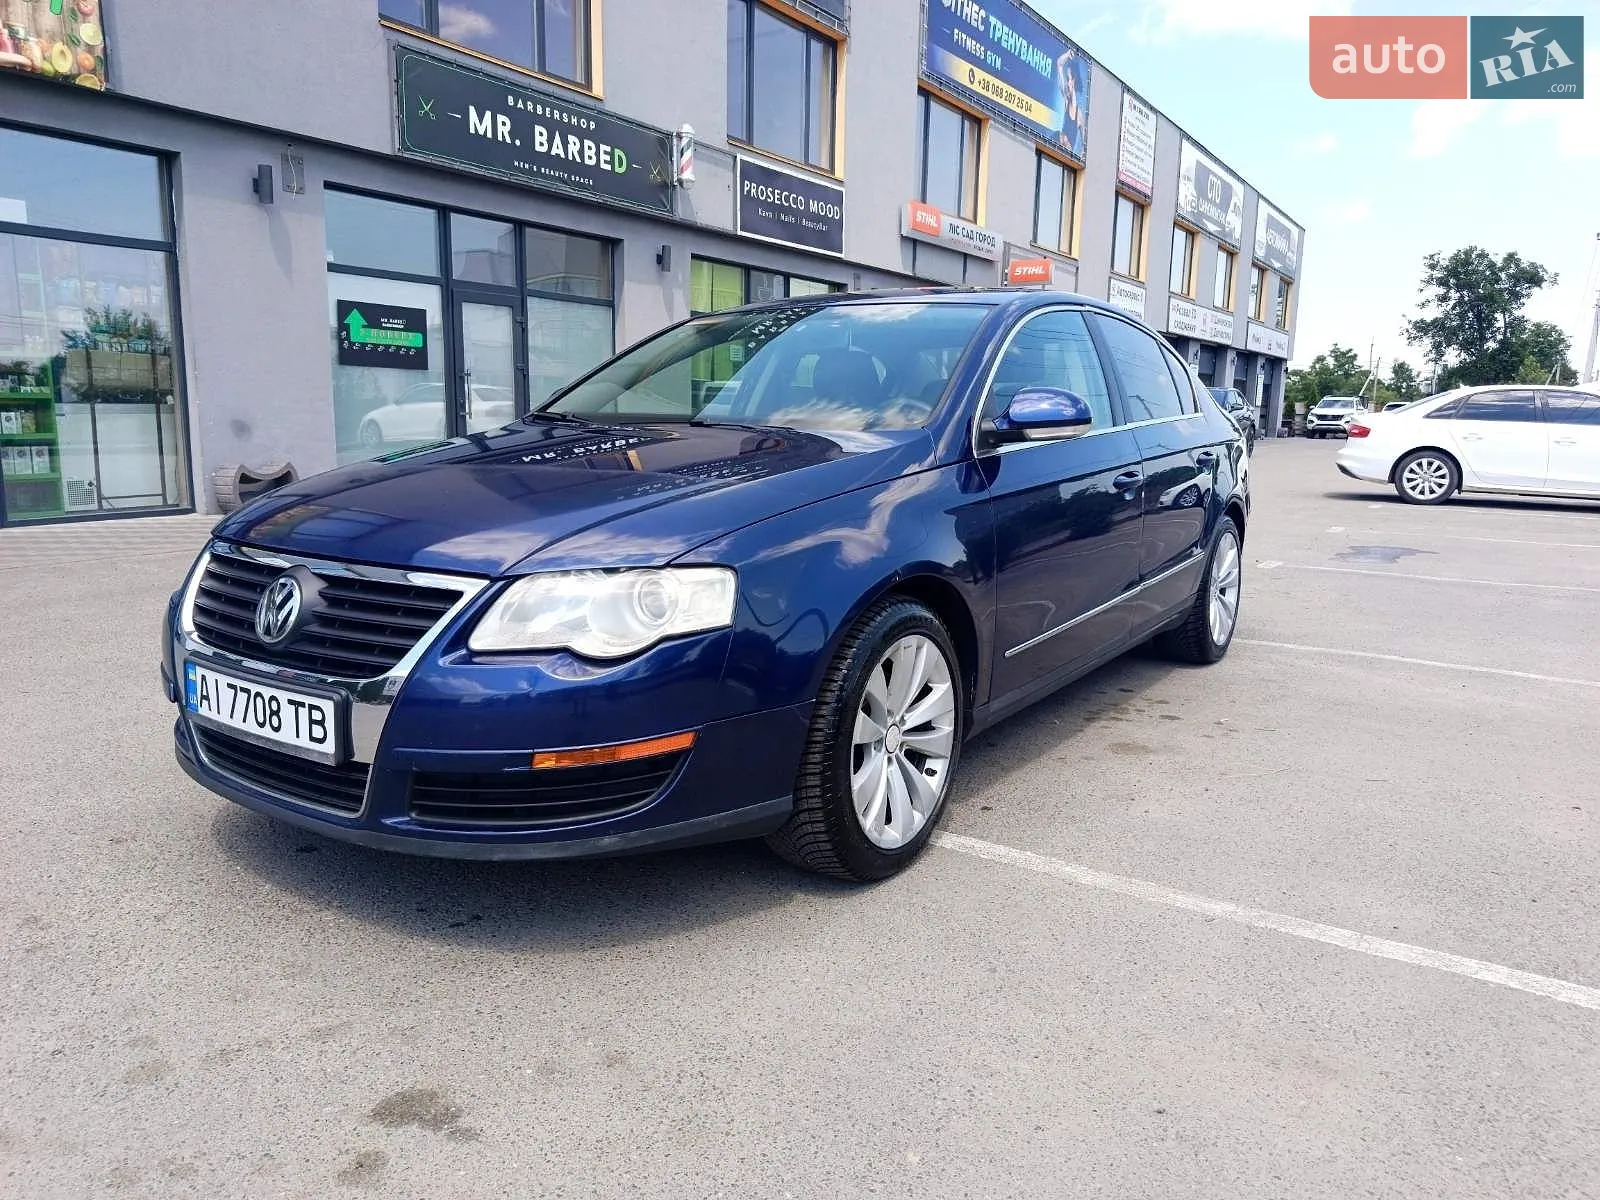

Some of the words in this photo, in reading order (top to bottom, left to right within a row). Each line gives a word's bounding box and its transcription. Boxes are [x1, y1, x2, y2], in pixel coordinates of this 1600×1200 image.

[953, 28, 985, 60] FITNESS
[985, 51, 1001, 71] GYM
[988, 14, 1053, 80] ТРЕНУВАННЯ
[977, 78, 990, 92] +38
[991, 82, 1003, 99] 068
[1004, 90, 1017, 104] 207
[1016, 97, 1025, 109] 25
[507, 95, 597, 131] BARBERSHOP
[468, 105, 521, 147] MR.
[534, 125, 627, 174] BARBED
[541, 167, 568, 179] BEAUTY
[571, 175, 593, 185] SPACE
[744, 180, 805, 210] PROSECCO
[809, 199, 840, 220] MOOD
[780, 213, 795, 223] Nails
[915, 211, 938, 227] STIHL
[949, 223, 960, 235] ЛІС
[961, 226, 975, 242] САД
[975, 232, 996, 248] ГОРОД
[1013, 265, 1046, 276] STIHL
[199, 674, 221, 715] AI
[226, 682, 282, 733] 7708
[287, 698, 328, 745] TB
